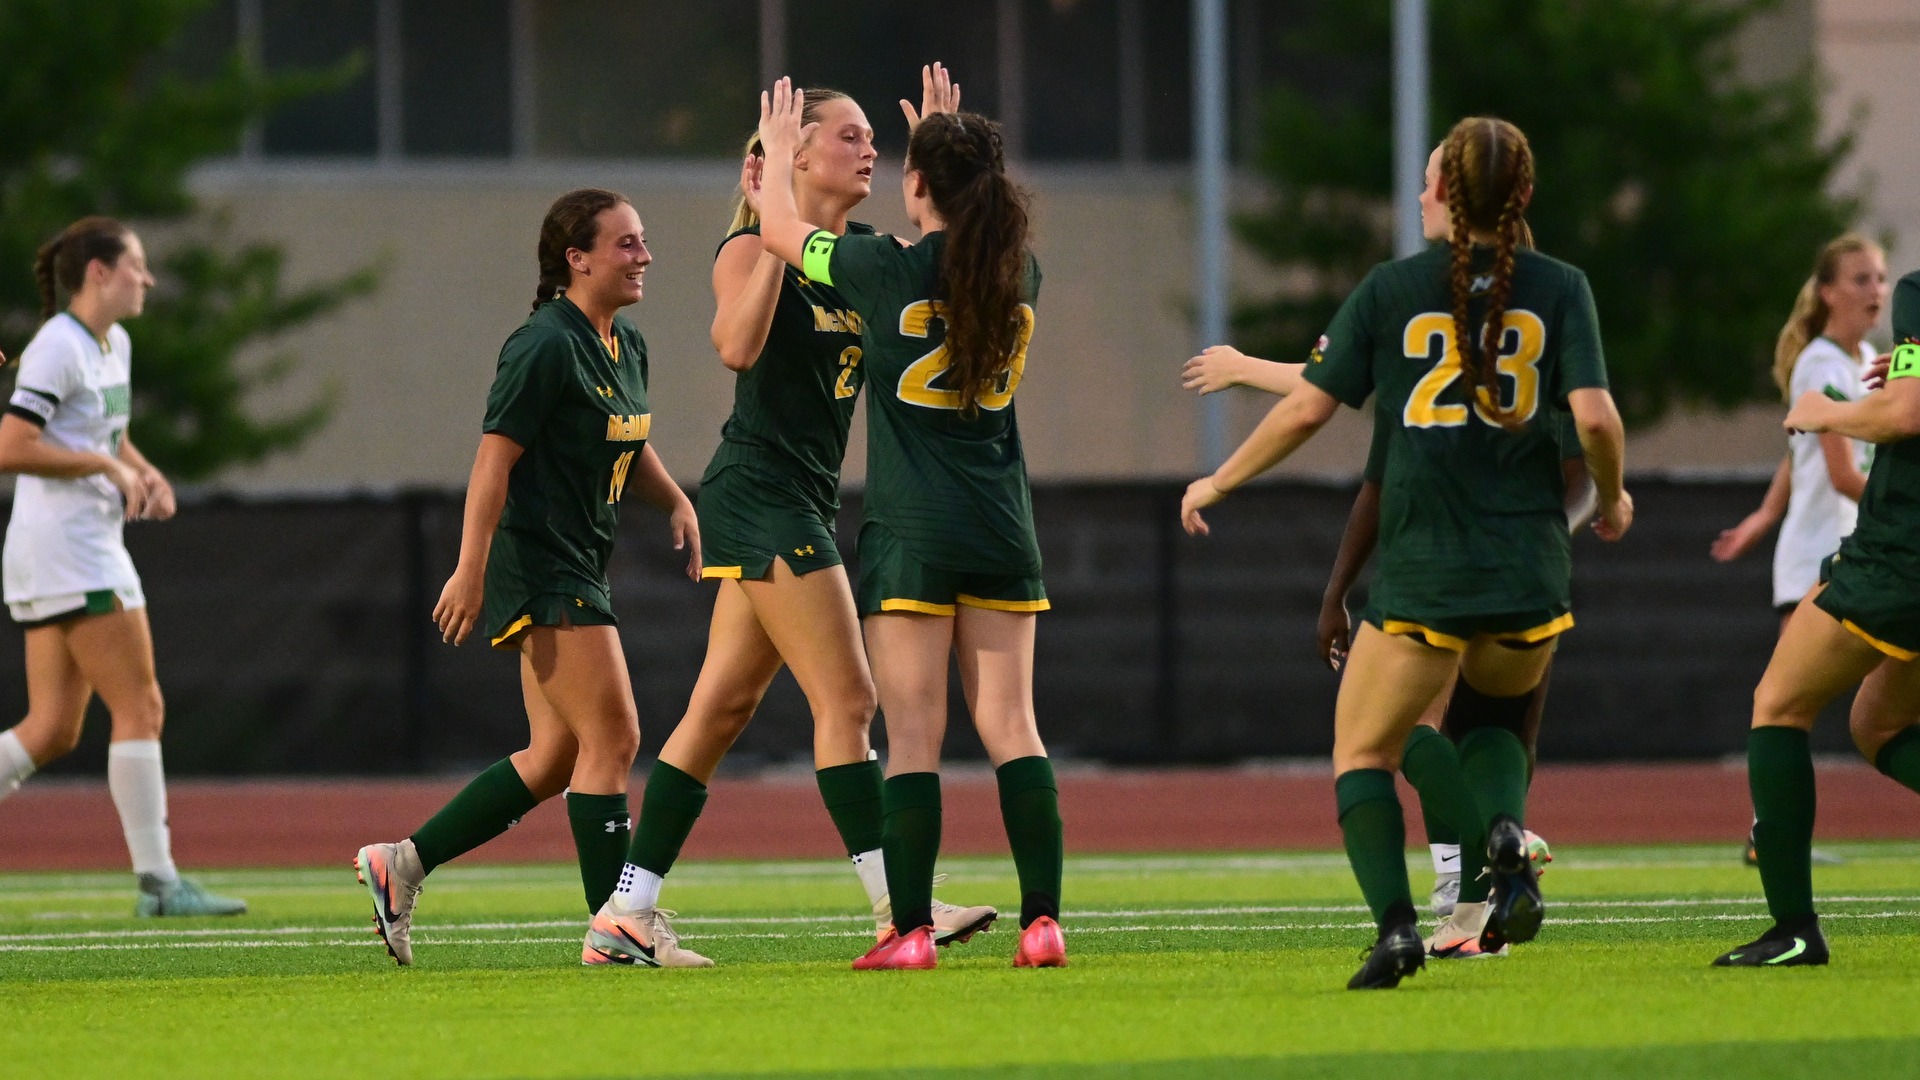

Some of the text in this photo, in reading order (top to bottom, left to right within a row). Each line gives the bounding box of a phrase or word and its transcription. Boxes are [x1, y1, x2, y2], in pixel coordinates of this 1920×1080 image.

[834, 345, 863, 400] 2
[1403, 309, 1546, 428] 23
[1893, 348, 1915, 372] C
